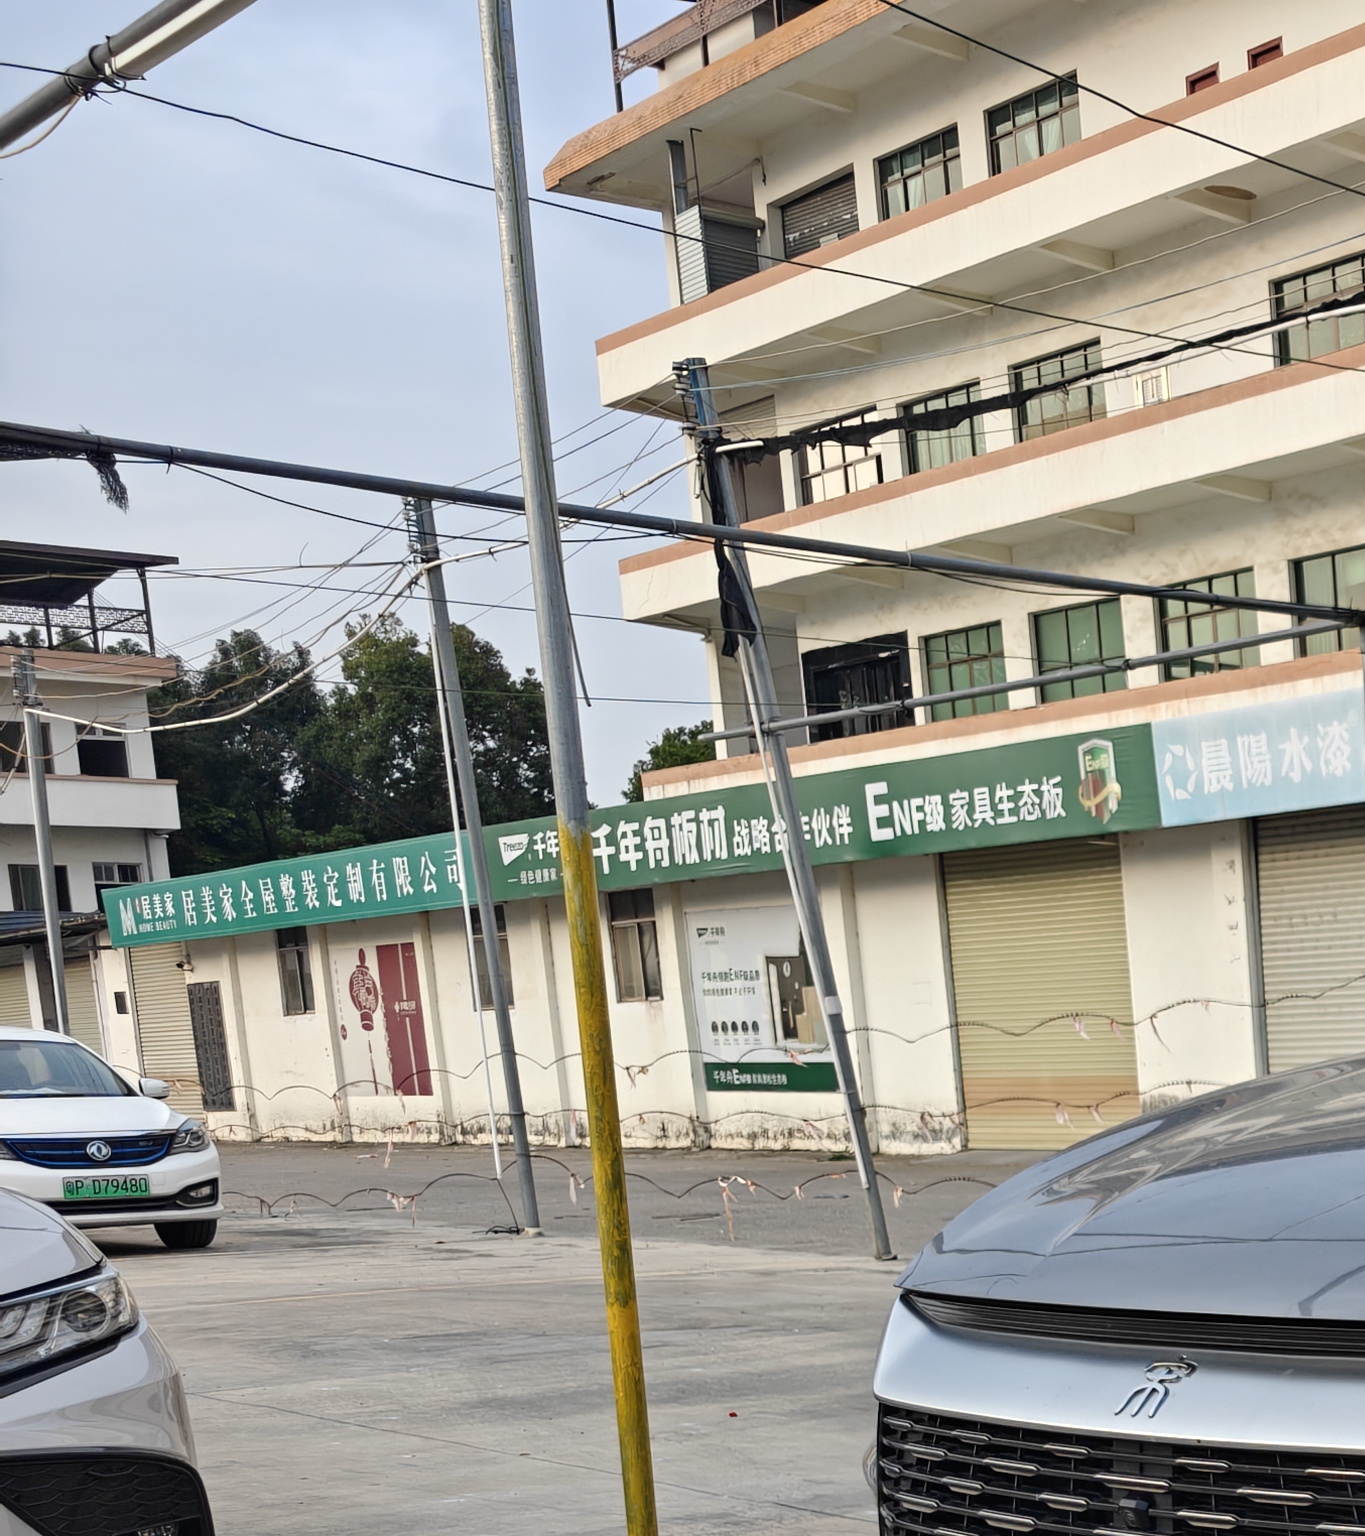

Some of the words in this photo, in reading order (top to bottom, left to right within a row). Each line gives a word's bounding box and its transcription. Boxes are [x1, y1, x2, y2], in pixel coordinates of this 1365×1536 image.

[1201, 721, 1352, 794] 晨陽水漆
[591, 804, 728, 875] 千年舟板材
[865, 781, 946, 843] ENF级
[948, 775, 1067, 832] 家具生态板
[141, 891, 176, 920] 居美家
